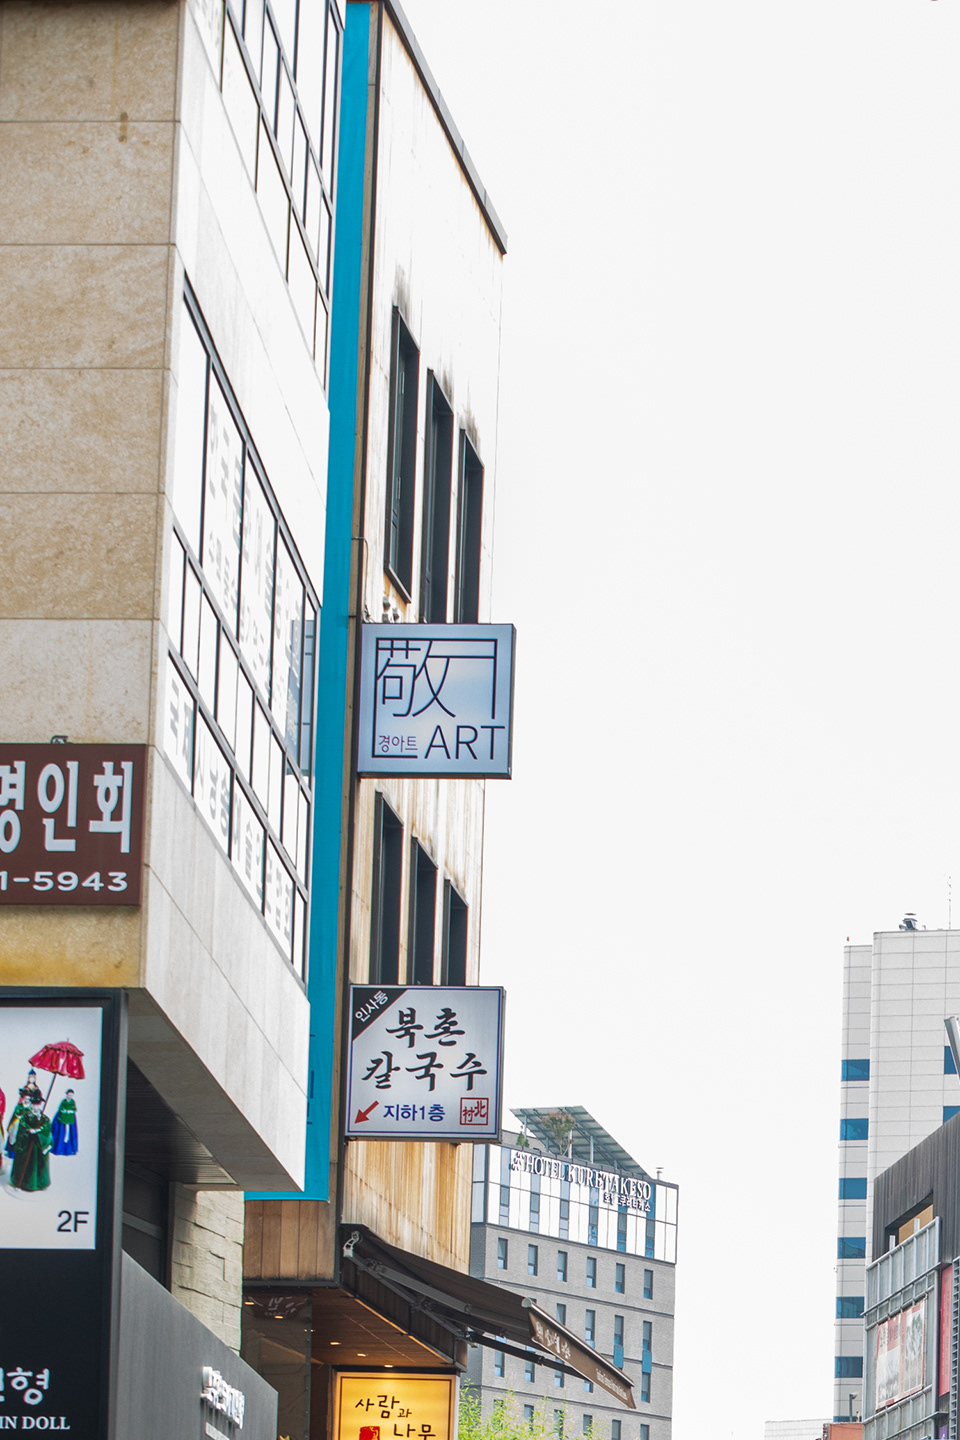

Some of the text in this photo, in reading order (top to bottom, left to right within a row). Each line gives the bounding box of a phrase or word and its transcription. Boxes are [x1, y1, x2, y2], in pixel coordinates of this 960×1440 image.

[378, 735, 418, 753] 경아트
[424, 725, 505, 760] ART
[355, 990, 389, 1022] 인사동
[385, 1007, 465, 1048] 북촌
[361, 1051, 487, 1091] 칼국수
[383, 1104, 446, 1122] 지하1층
[525, 1156, 651, 1199] HOTEL KURETAKESO
[57, 1210, 89, 1232] 2F
[355, 1395, 412, 1419] 사람과
[22, 1417, 71, 1430] DOLL
[393, 1423, 436, 1440] 나무
